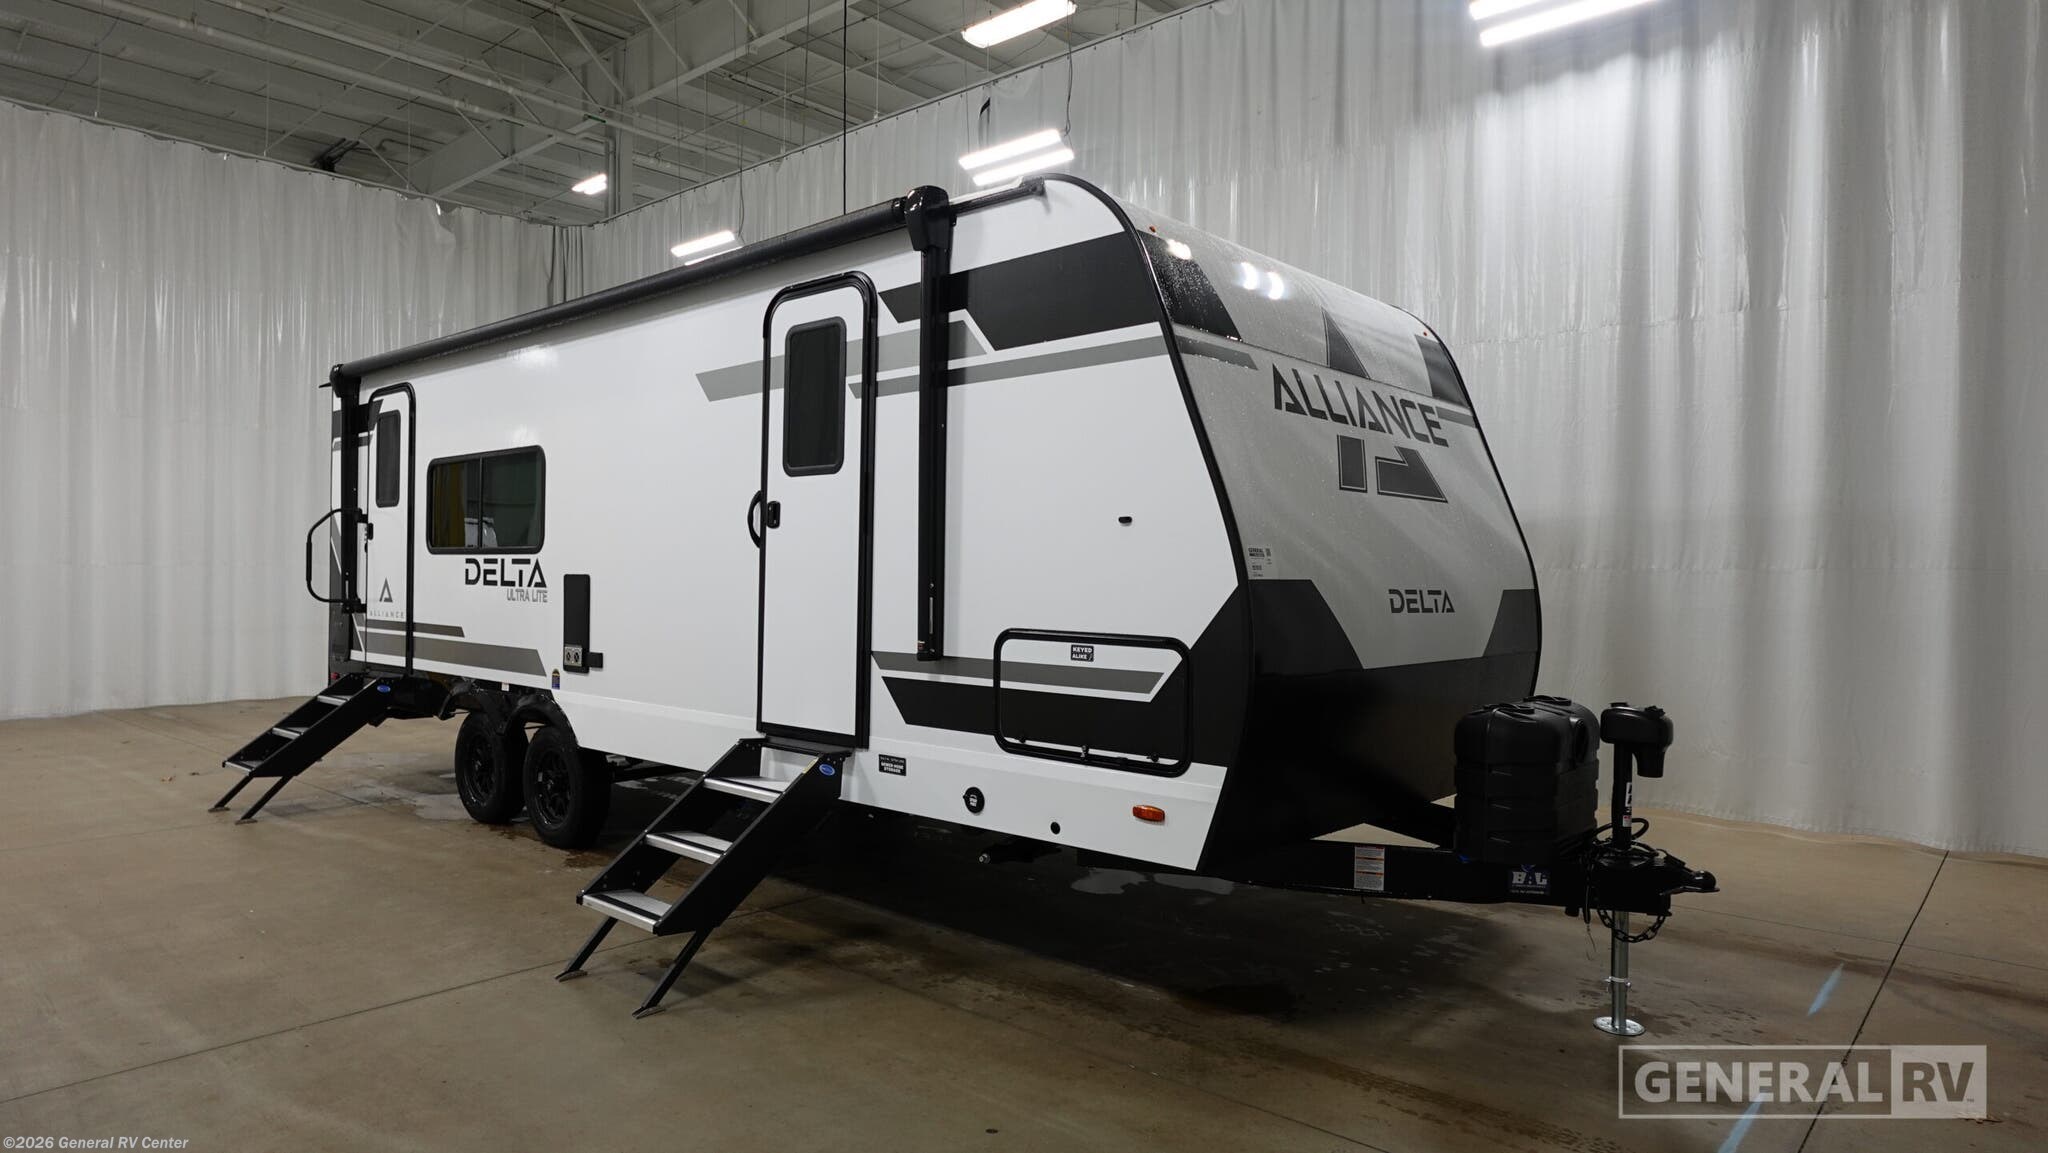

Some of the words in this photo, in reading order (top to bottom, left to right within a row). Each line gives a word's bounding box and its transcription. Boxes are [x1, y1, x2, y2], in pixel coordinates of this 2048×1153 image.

[1272, 363, 1449, 448] ALLIANCE
[465, 558, 547, 588] DELTA
[506, 589, 530, 602] ULTRA
[532, 590, 548, 603] LITE
[1388, 588, 1455, 613] DELTA
